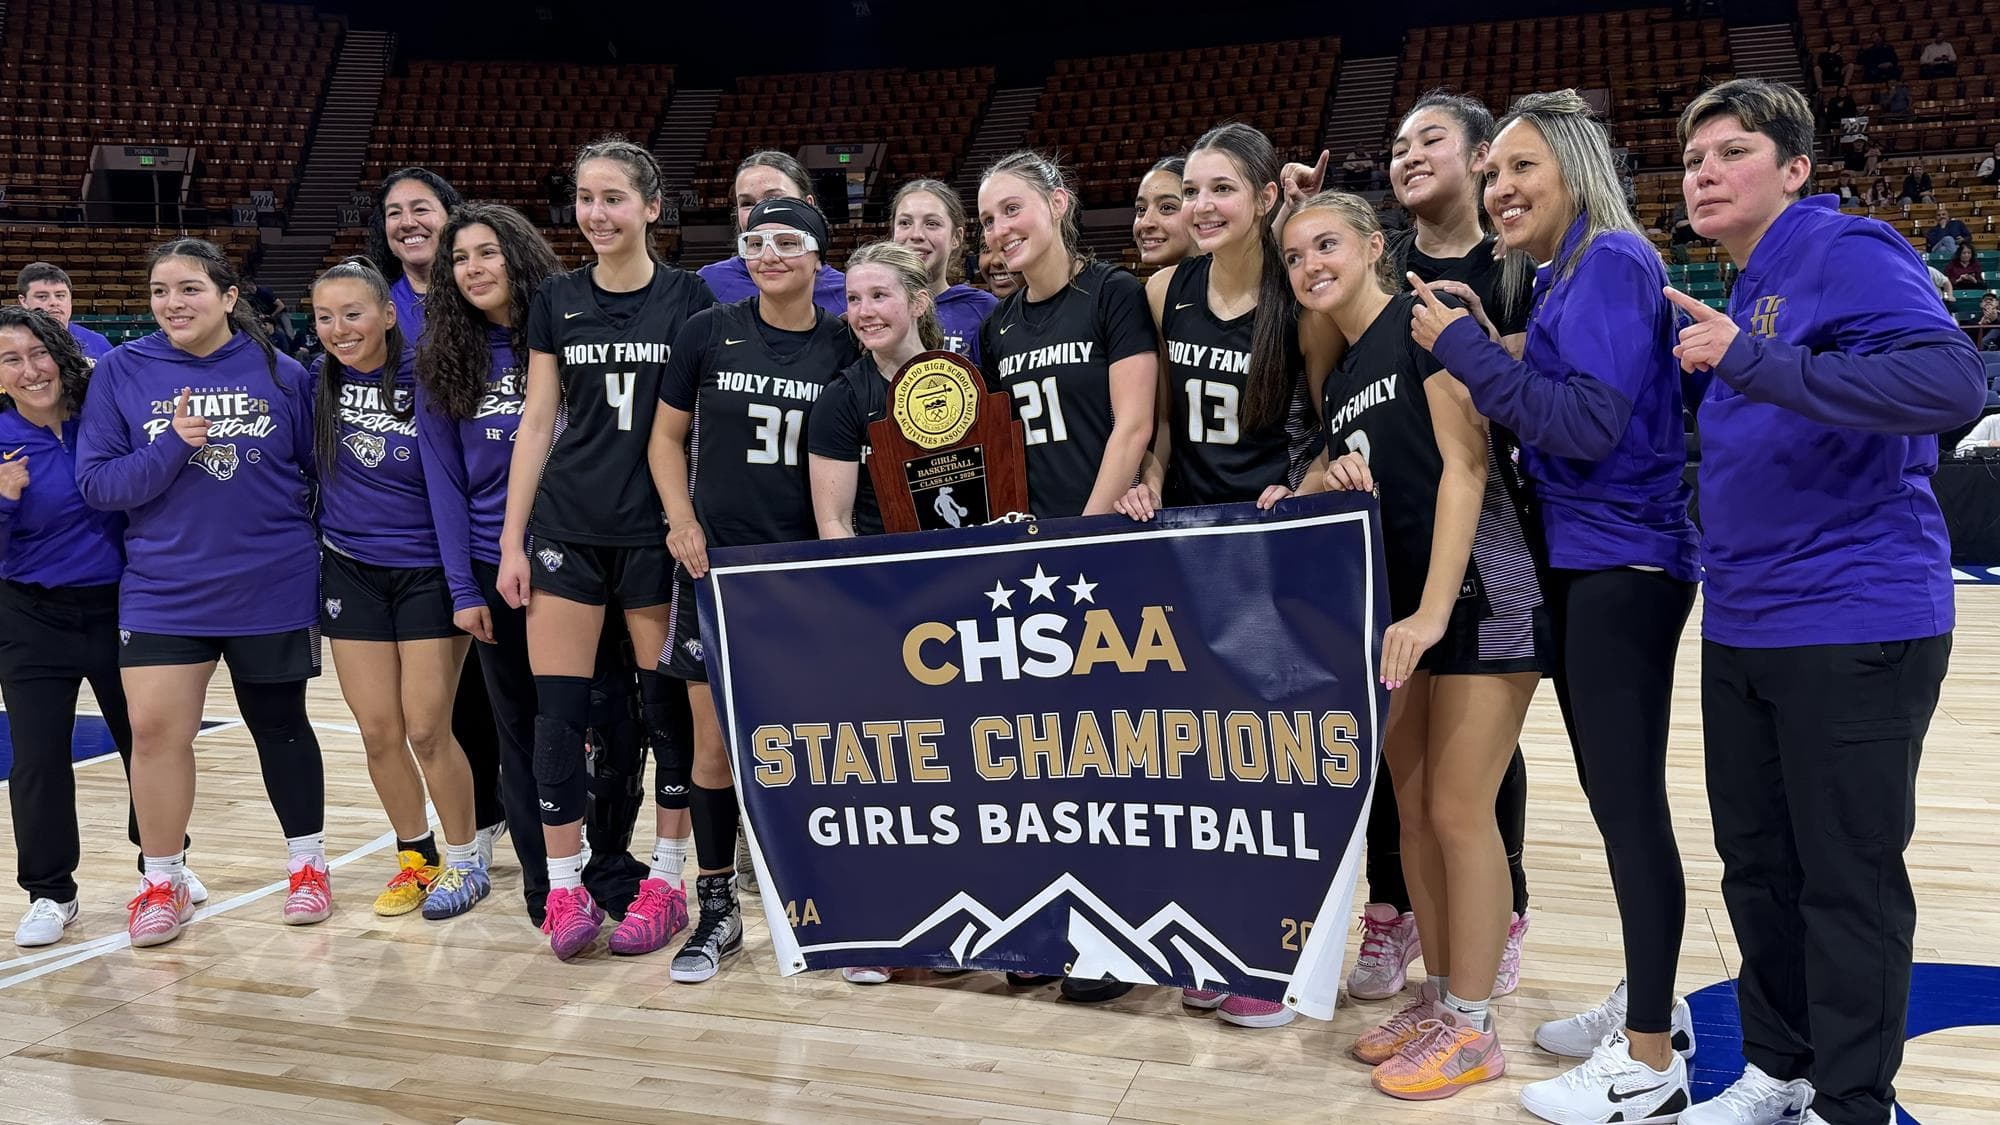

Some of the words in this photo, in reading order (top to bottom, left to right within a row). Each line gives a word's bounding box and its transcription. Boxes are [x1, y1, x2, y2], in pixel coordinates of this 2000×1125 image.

[238, 209, 257, 226] 122
[341, 209, 360, 224] 123
[564, 343, 610, 366] HOLY
[612, 342, 672, 364] FAMIL
[998, 352, 1028, 380] OLY
[1028, 341, 1094, 370] FAMILY
[1167, 340, 1208, 367] HOLY
[1208, 347, 1252, 375] FAM
[717, 371, 770, 394] HOLY
[772, 377, 824, 403] FAMI
[924, 362, 946, 372] HIGH
[946, 365, 972, 393] SCHOOL
[151, 400, 173, 415] 20
[248, 397, 269, 413] 26
[605, 372, 636, 431] 4
[1012, 376, 1068, 446] 21
[1184, 378, 1239, 445] 13
[1345, 373, 1397, 423] FAMILY
[143, 416, 277, 445] Betball
[746, 403, 804, 466] 31
[901, 418, 938, 445] ACTIVITIES
[940, 401, 975, 444] ASSOCIATION
[917, 459, 975, 478] BASKETBALL
[930, 454, 958, 466] GIRLS
[920, 479, 943, 488] CLASS
[902, 606, 1187, 686] CHSAA
[752, 719, 951, 788] STATE
[970, 709, 1360, 788] CHAMPIONS
[808, 805, 960, 846] GIRLS
[977, 801, 1320, 861] BASKETBALL
[785, 898, 822, 928] 4A
